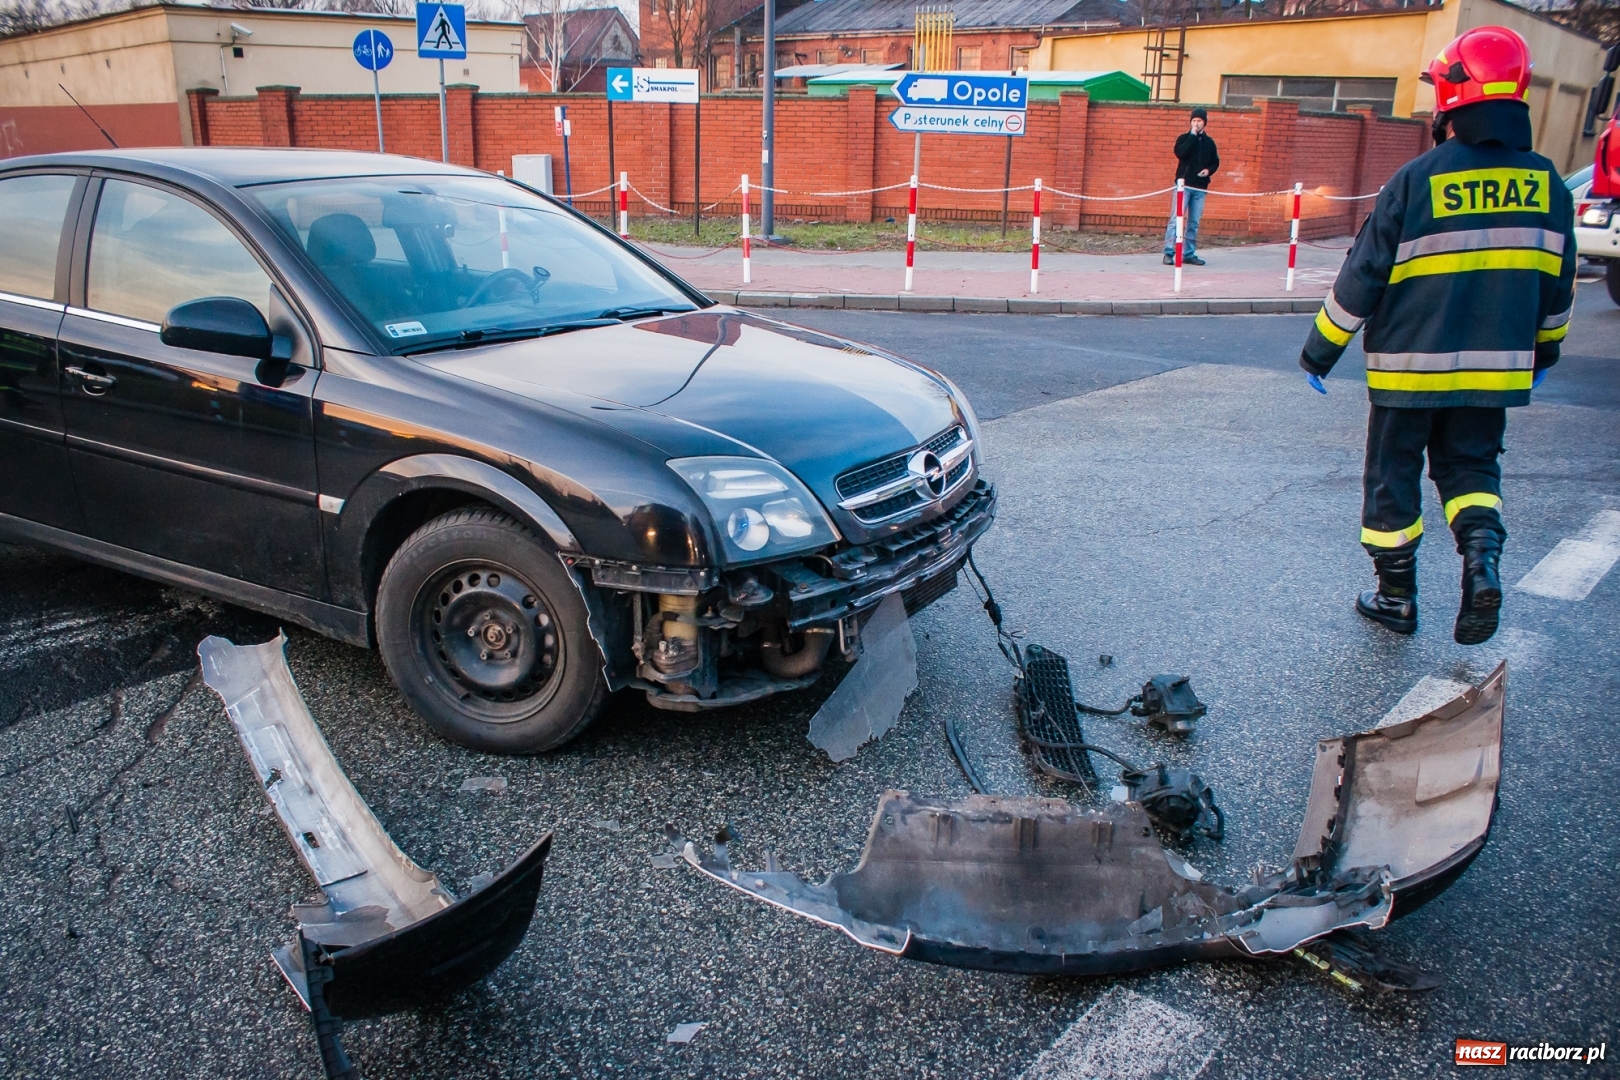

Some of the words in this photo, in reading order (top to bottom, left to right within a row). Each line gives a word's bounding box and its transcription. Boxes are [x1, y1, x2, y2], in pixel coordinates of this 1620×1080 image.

[953, 81, 1021, 106] Opole
[974, 116, 1004, 131] celny
[1443, 173, 1540, 211] STRAŻ
